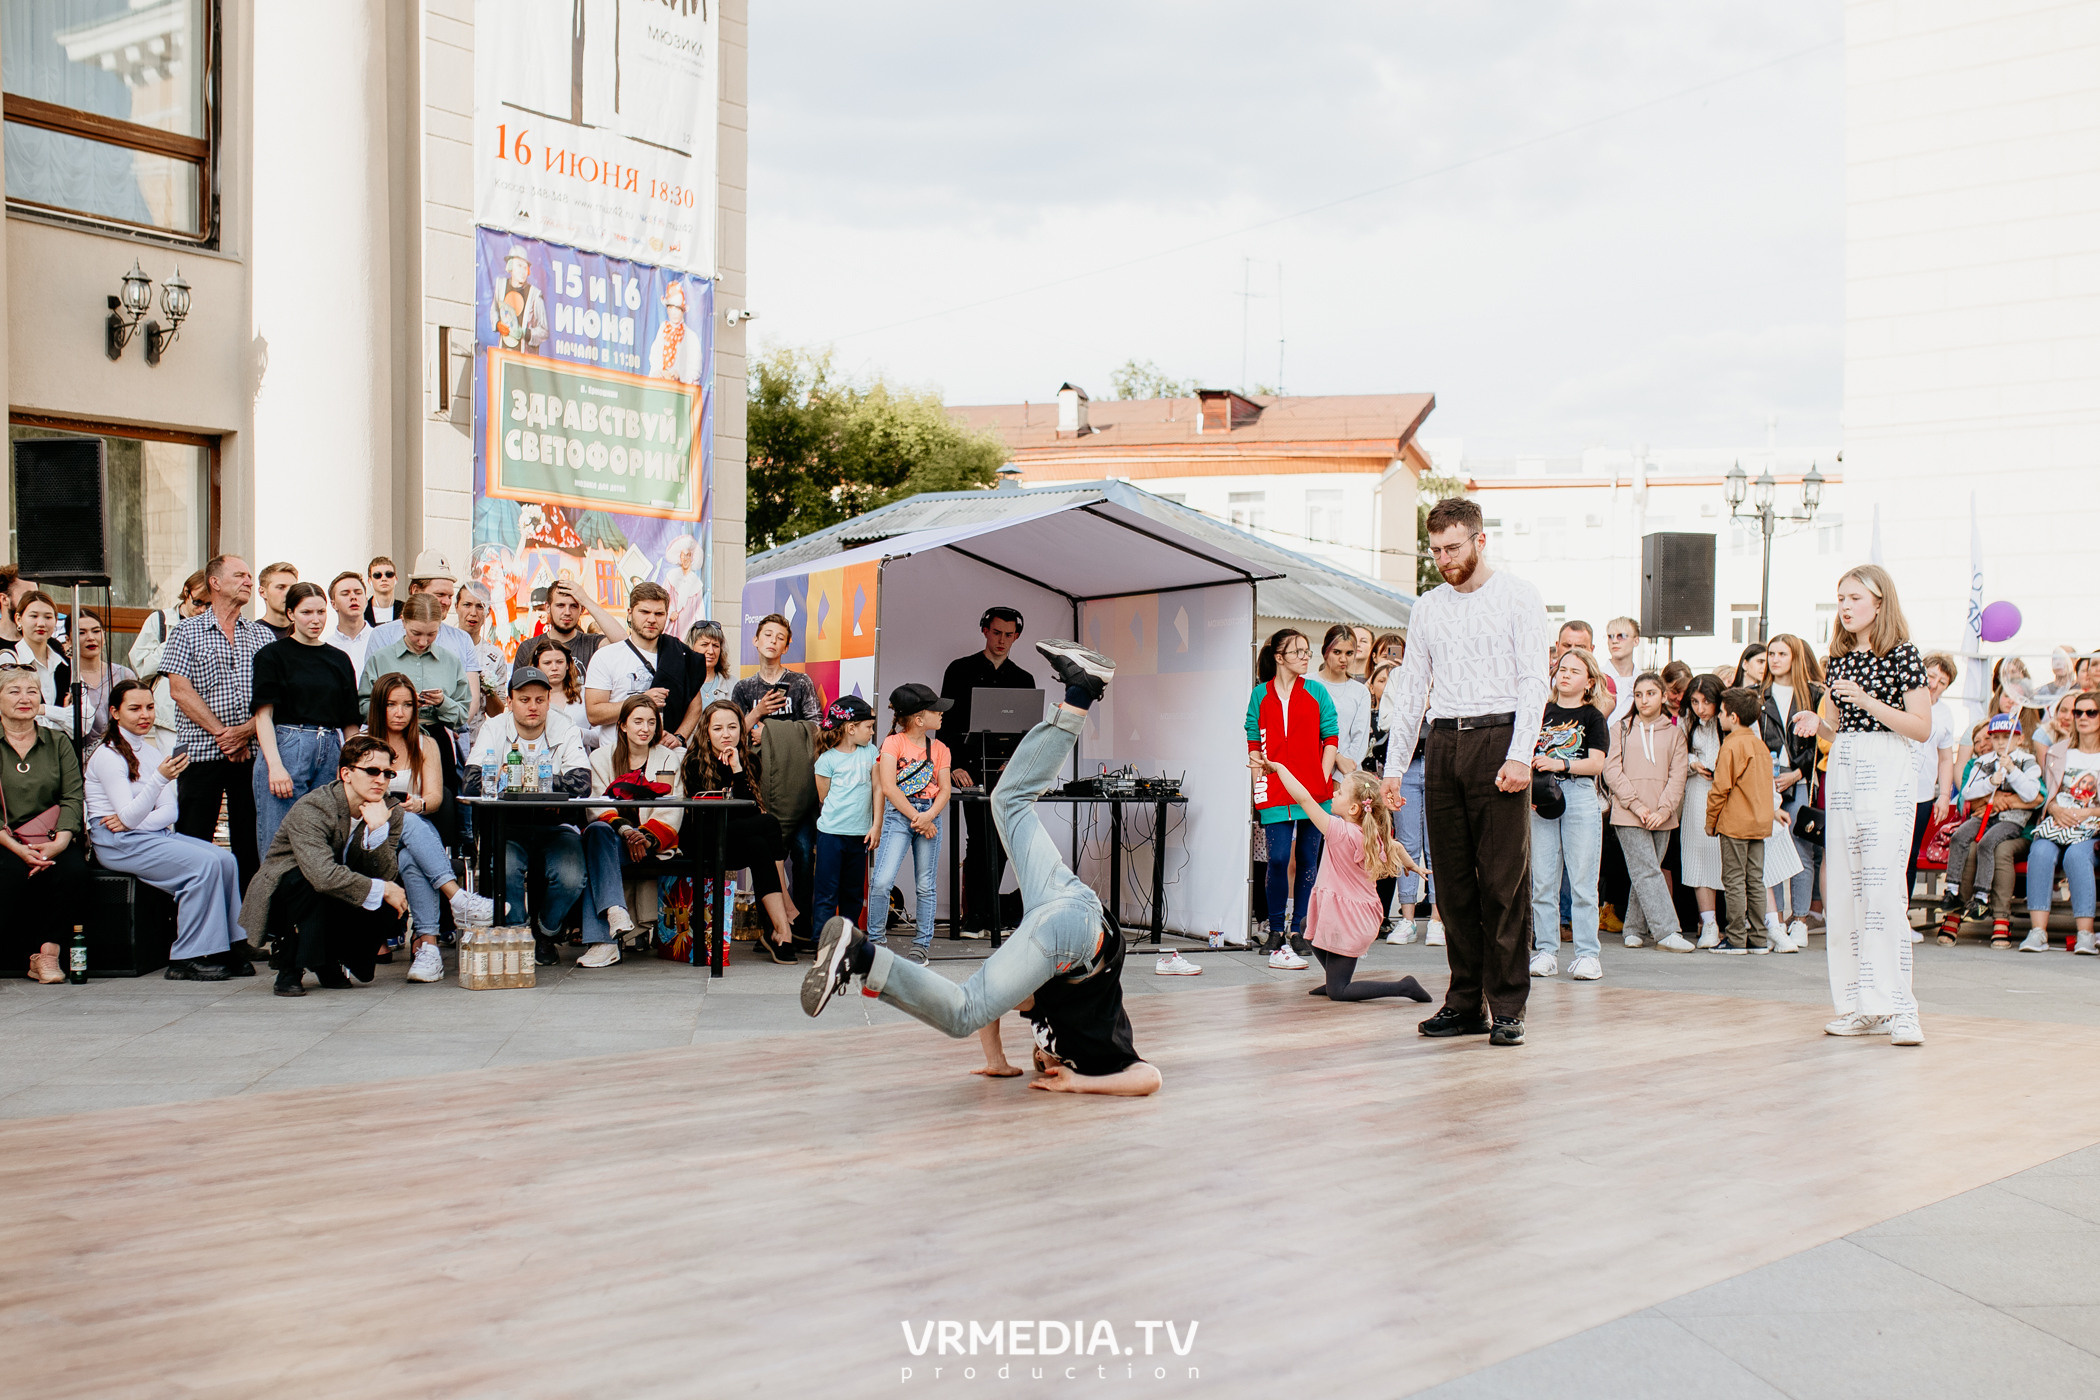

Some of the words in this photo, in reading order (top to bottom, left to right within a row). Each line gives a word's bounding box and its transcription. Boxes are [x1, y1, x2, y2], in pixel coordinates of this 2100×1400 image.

[648, 25, 704, 58] МЮЗИКЛ
[495, 123, 532, 166] 16
[650, 178, 694, 209] 18:30
[552, 260, 583, 298] 15
[612, 272, 641, 311] 16
[555, 302, 634, 346] ИЮНЯ
[555, 339, 599, 361] НАЧАЛО
[613, 351, 641, 369] 11:00
[510, 389, 684, 450] ЗДРАВСТВУЙ,
[504, 428, 687, 484] СВЕТОФОРИК!
[1991, 719, 2014, 732] LUCKY
